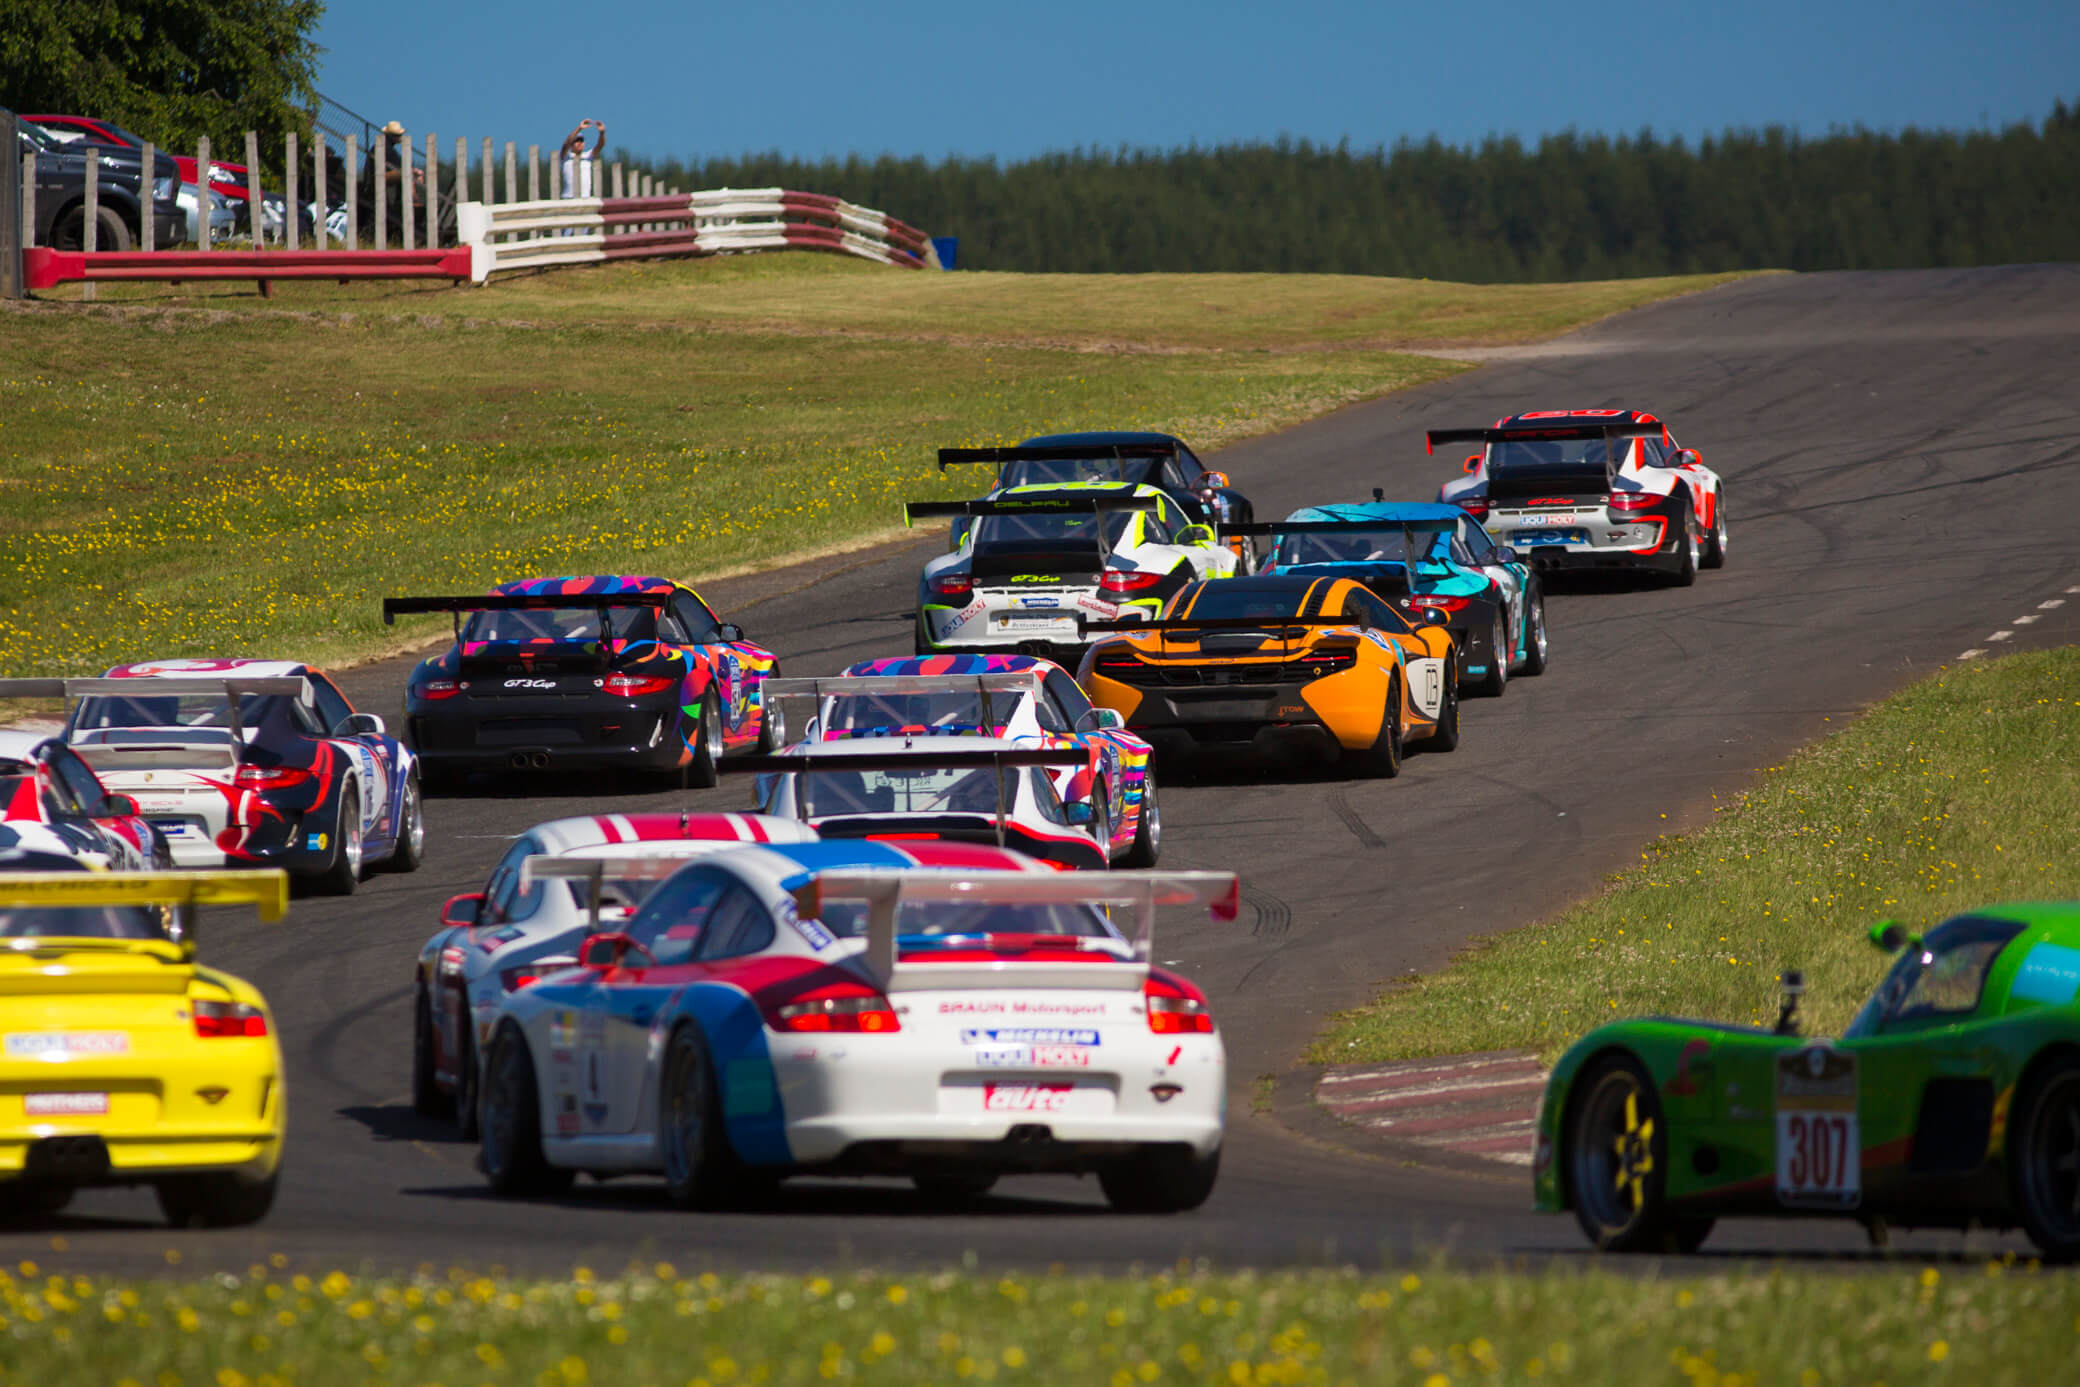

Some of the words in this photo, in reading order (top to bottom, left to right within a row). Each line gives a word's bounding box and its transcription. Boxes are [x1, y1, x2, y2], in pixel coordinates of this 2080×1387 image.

[1547, 514, 1575, 525] MOLY
[962, 598, 986, 622] MOLY
[503, 679, 533, 688] GT3
[532, 678, 557, 690] Cup
[938, 1001, 1005, 1014] BRAUN
[1012, 1001, 1107, 1016] Motorsport
[994, 1029, 1097, 1045] MICHELIN
[1034, 1046, 1089, 1066] MOLY
[985, 1085, 1072, 1111] auto
[1788, 1115, 1848, 1188] 307
